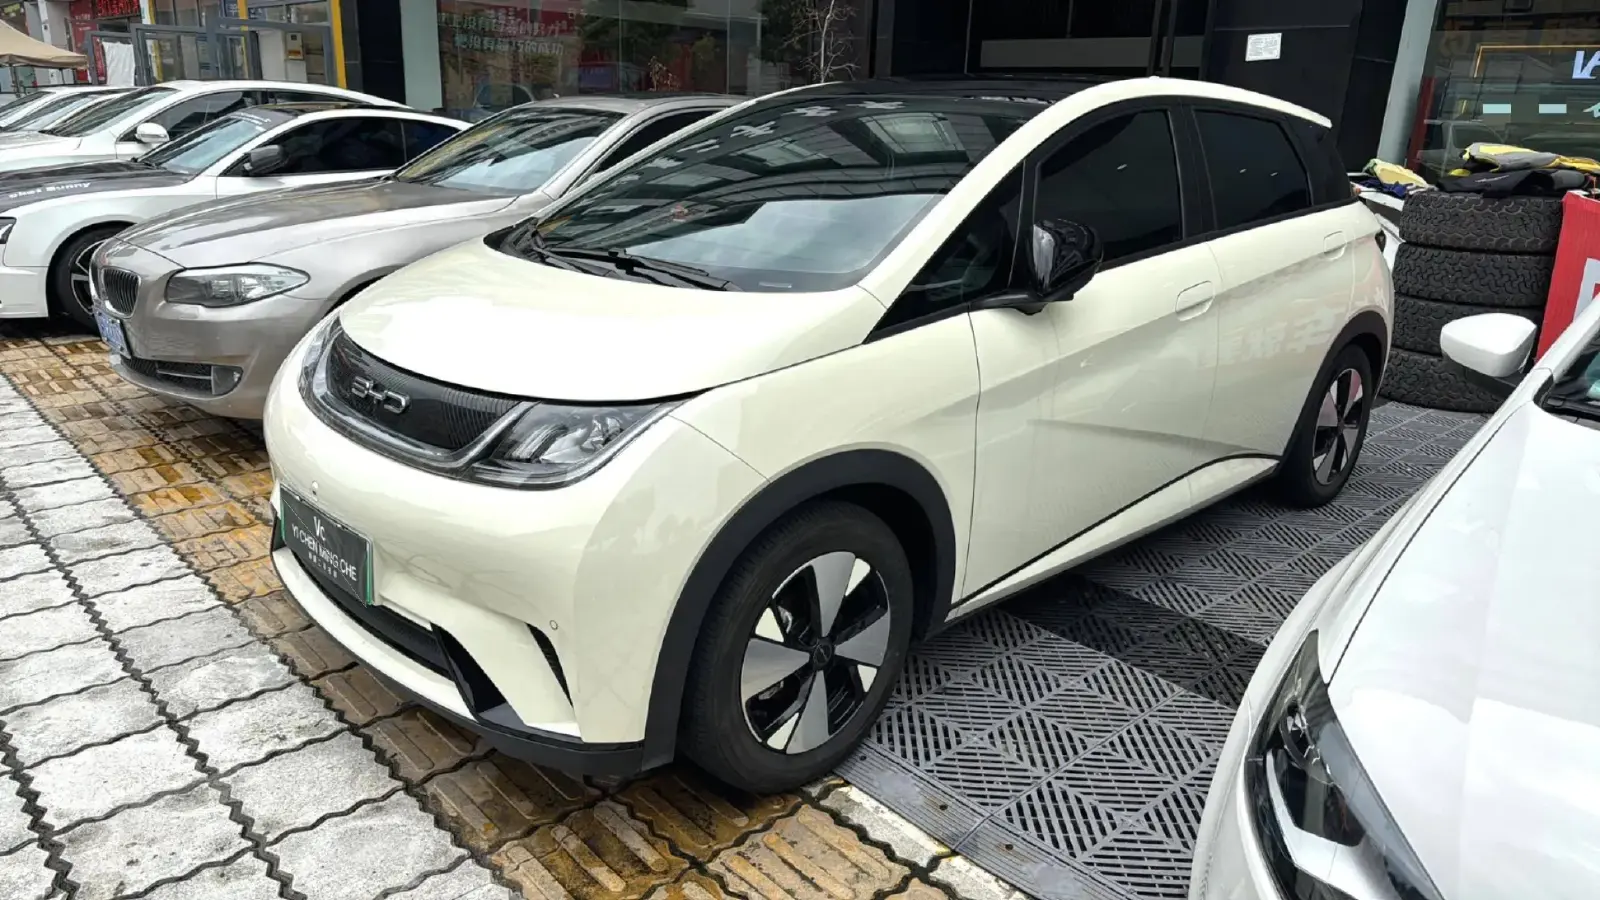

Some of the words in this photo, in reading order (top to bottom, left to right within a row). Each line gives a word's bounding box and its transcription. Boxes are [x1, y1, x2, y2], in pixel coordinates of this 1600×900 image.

[351, 376, 410, 414] BYD
[300, 529, 318, 554] CHEN
[319, 544, 339, 568] MING
[339, 558, 357, 582] CHE
